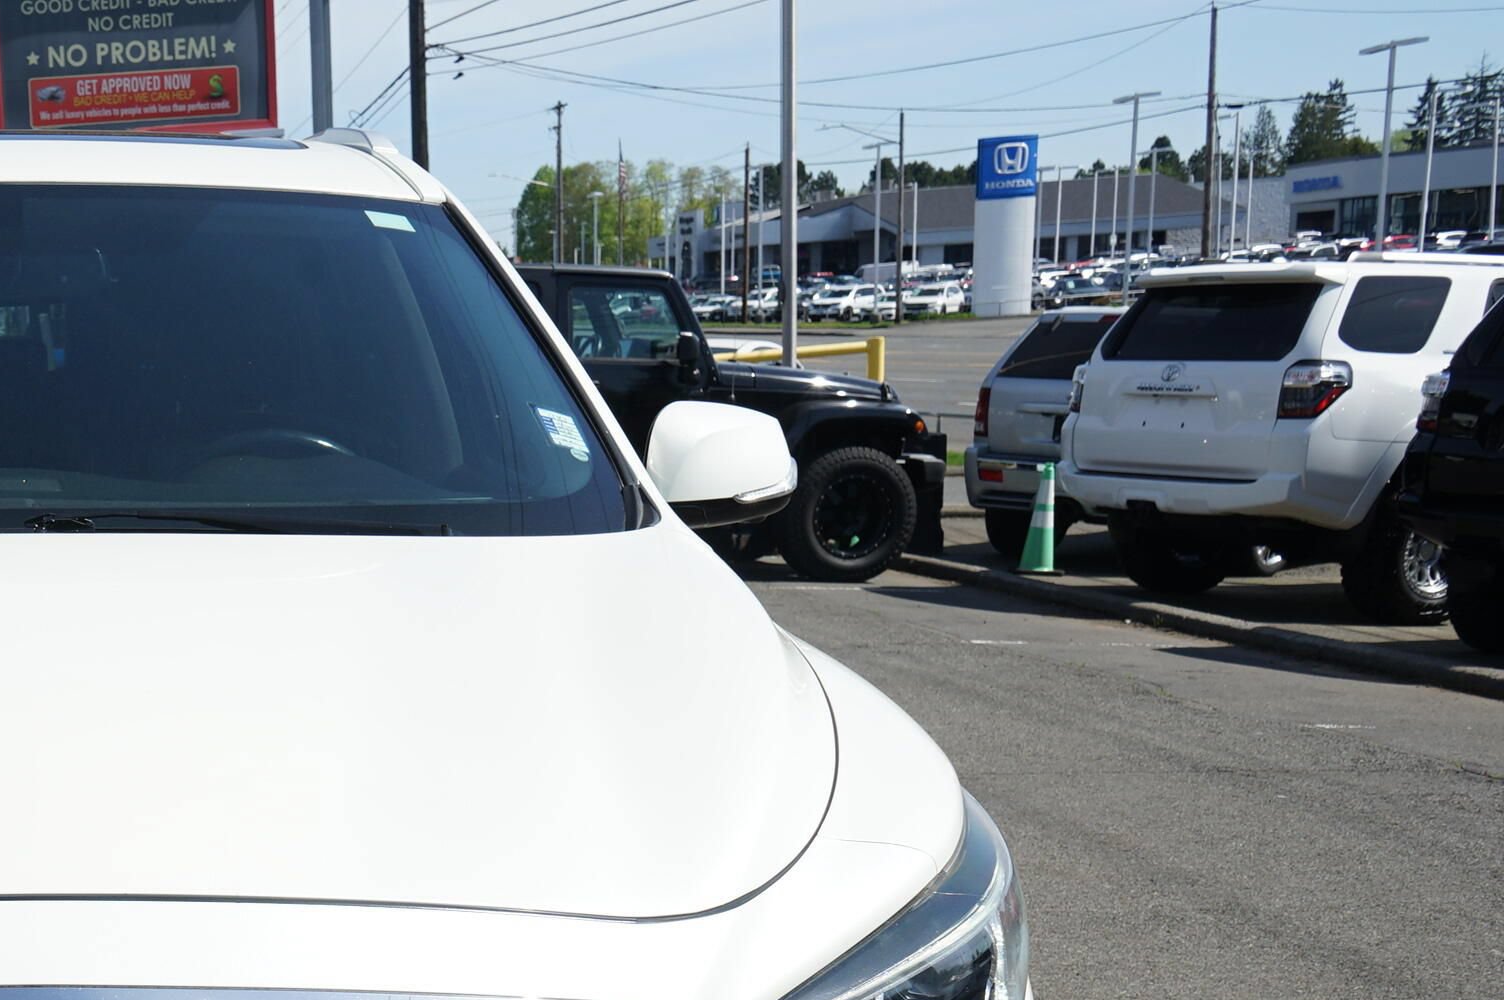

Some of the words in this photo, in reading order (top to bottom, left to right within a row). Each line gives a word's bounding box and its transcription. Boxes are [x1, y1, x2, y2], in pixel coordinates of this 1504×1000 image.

[20, 0, 73, 15] GOOD
[88, 16, 114, 32] NO
[119, 12, 174, 30] CREDIT
[47, 44, 88, 68] NO
[96, 35, 217, 66] PROBLEM!
[76, 79, 98, 96] GET
[101, 75, 161, 94] APPROVED
[164, 73, 191, 90] NOW
[73, 95, 92, 106] BAD
[95, 93, 128, 105] CREDIT
[134, 92, 149, 102] WE
[151, 91, 170, 102] CAN
[173, 89, 196, 100] HELP
[40, 111, 51, 120] We
[188, 100, 209, 114] perfect
[985, 178, 1035, 190] HONDA
